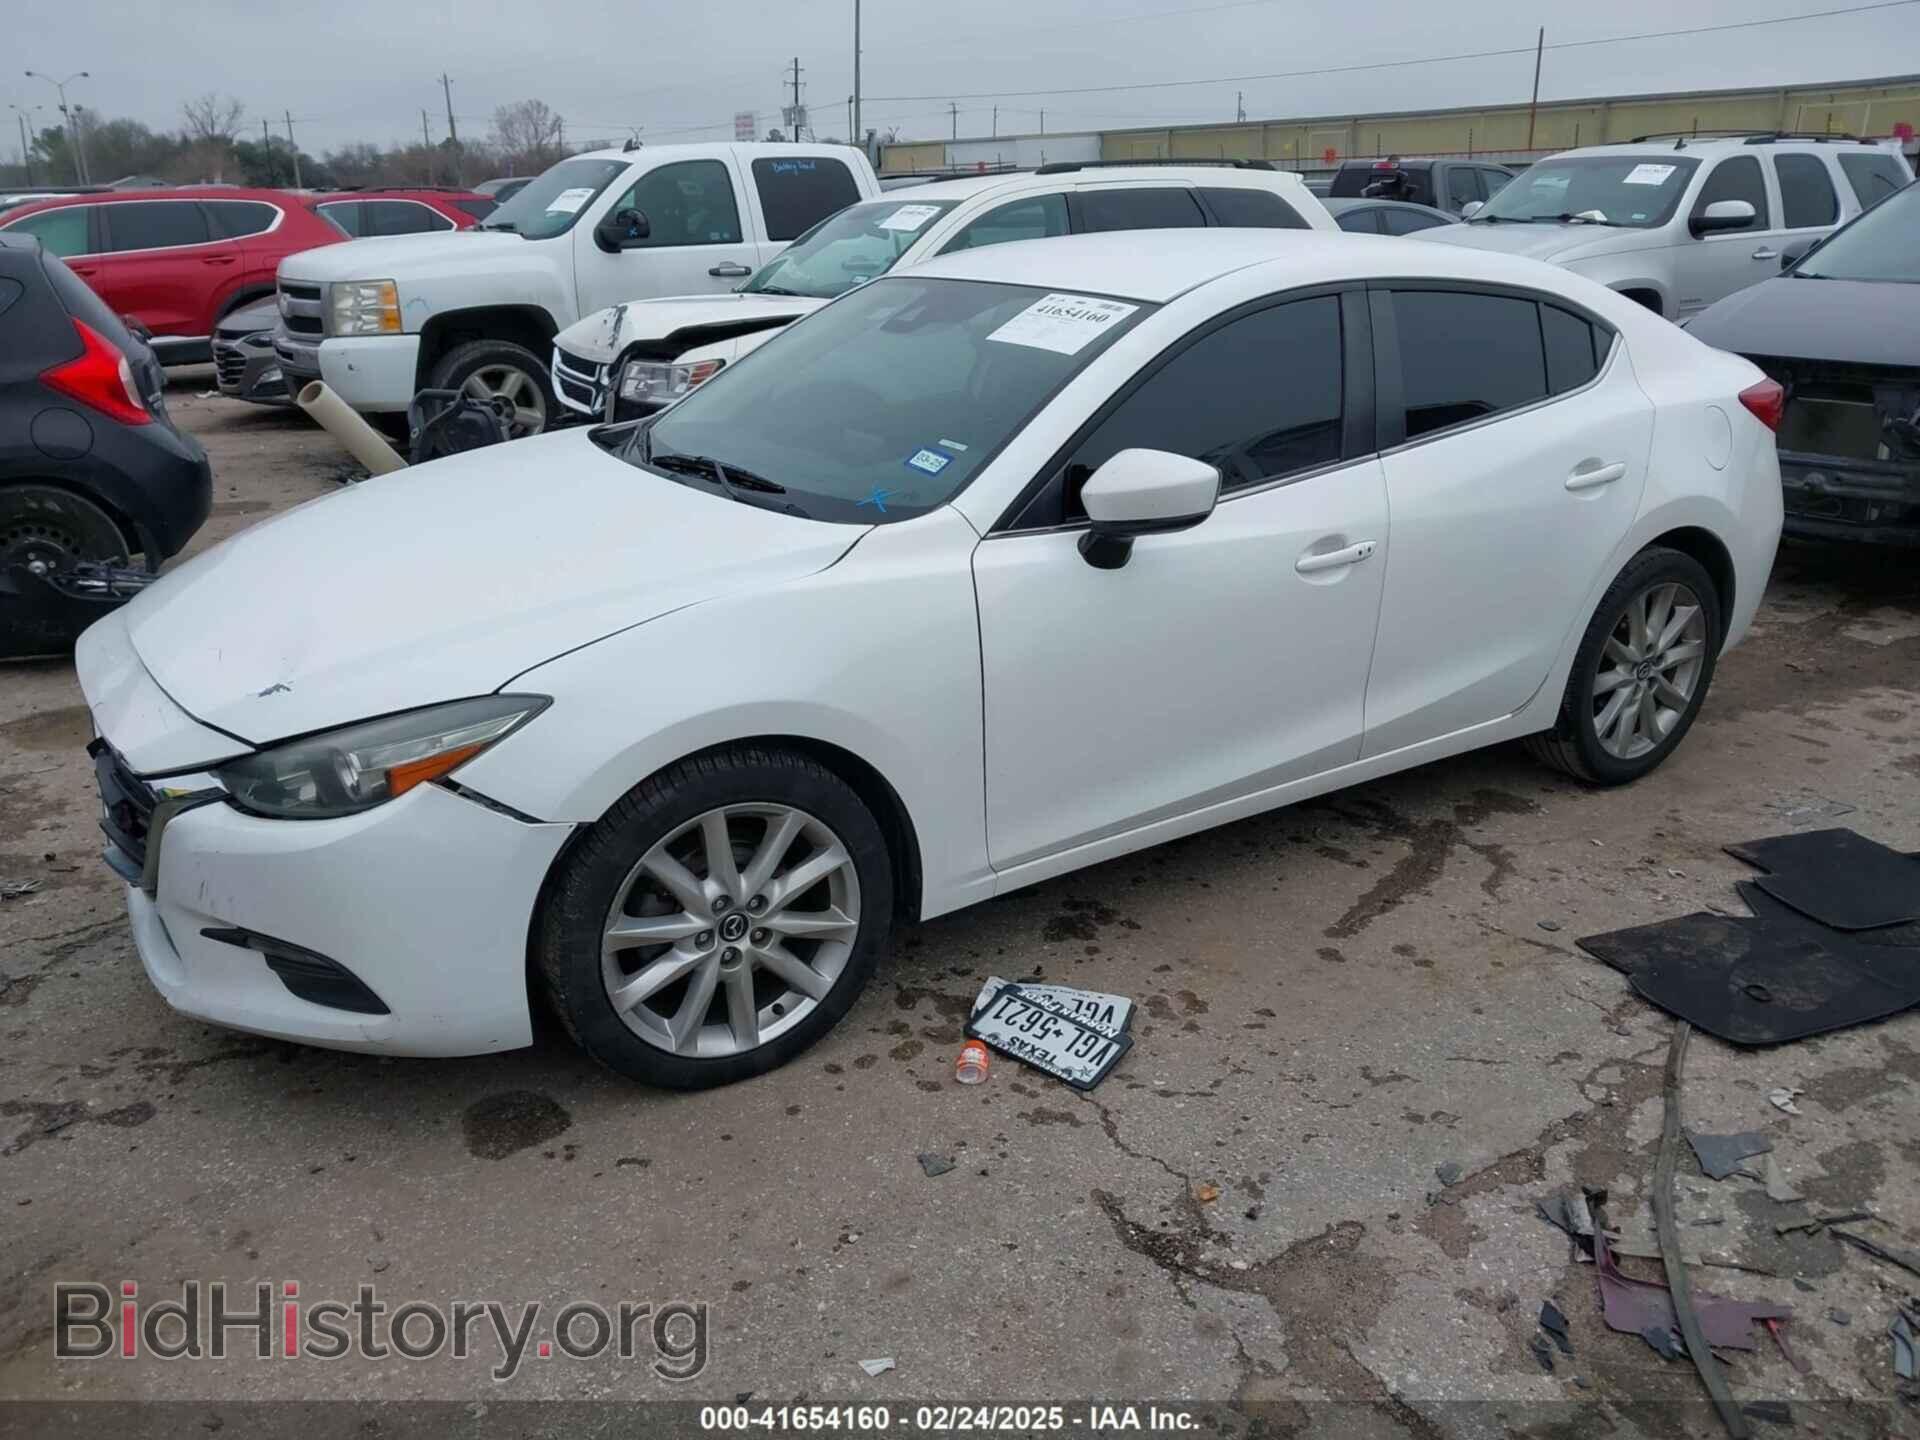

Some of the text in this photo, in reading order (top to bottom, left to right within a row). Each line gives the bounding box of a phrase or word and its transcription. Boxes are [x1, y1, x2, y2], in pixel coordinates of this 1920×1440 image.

[1037, 305, 1111, 322] 41654160
[993, 997, 1115, 1066] VGL 5621
[1010, 1036, 1057, 1063] TEXAS
